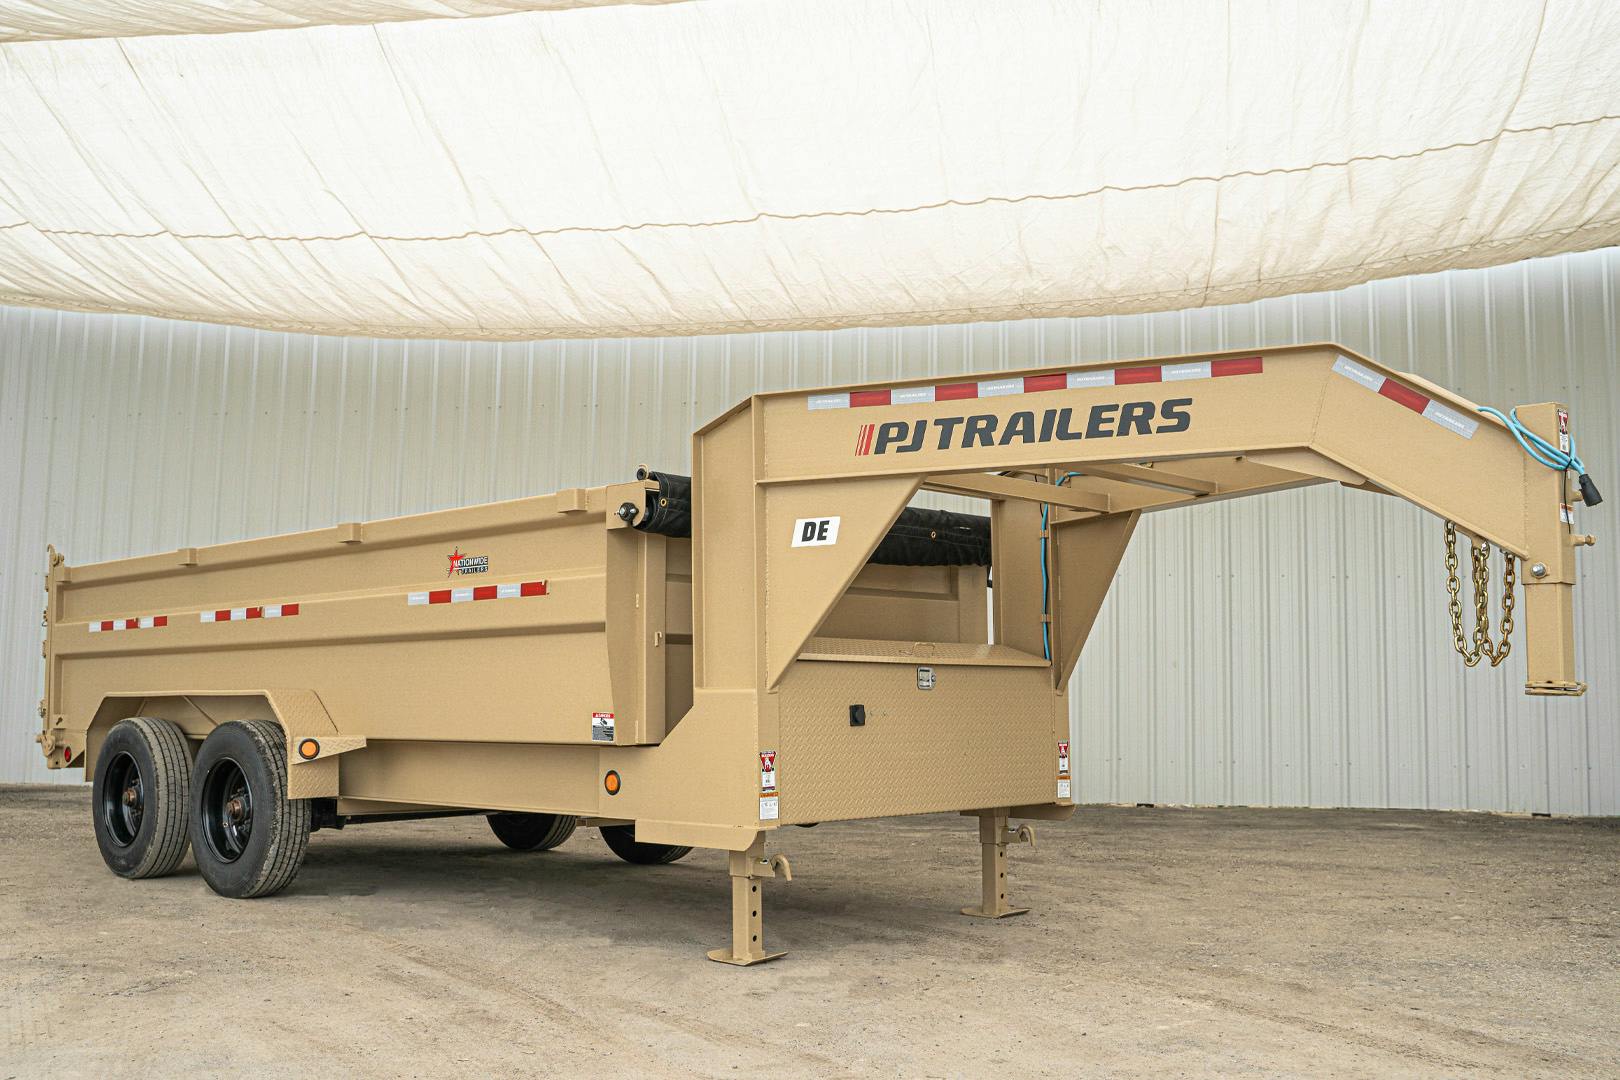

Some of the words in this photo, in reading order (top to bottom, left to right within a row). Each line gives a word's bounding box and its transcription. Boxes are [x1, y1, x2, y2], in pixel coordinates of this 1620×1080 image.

[933, 397, 1193, 451] TRAILERS
[801, 520, 830, 542] DE
[453, 556, 488, 567] NATIONWIDE
